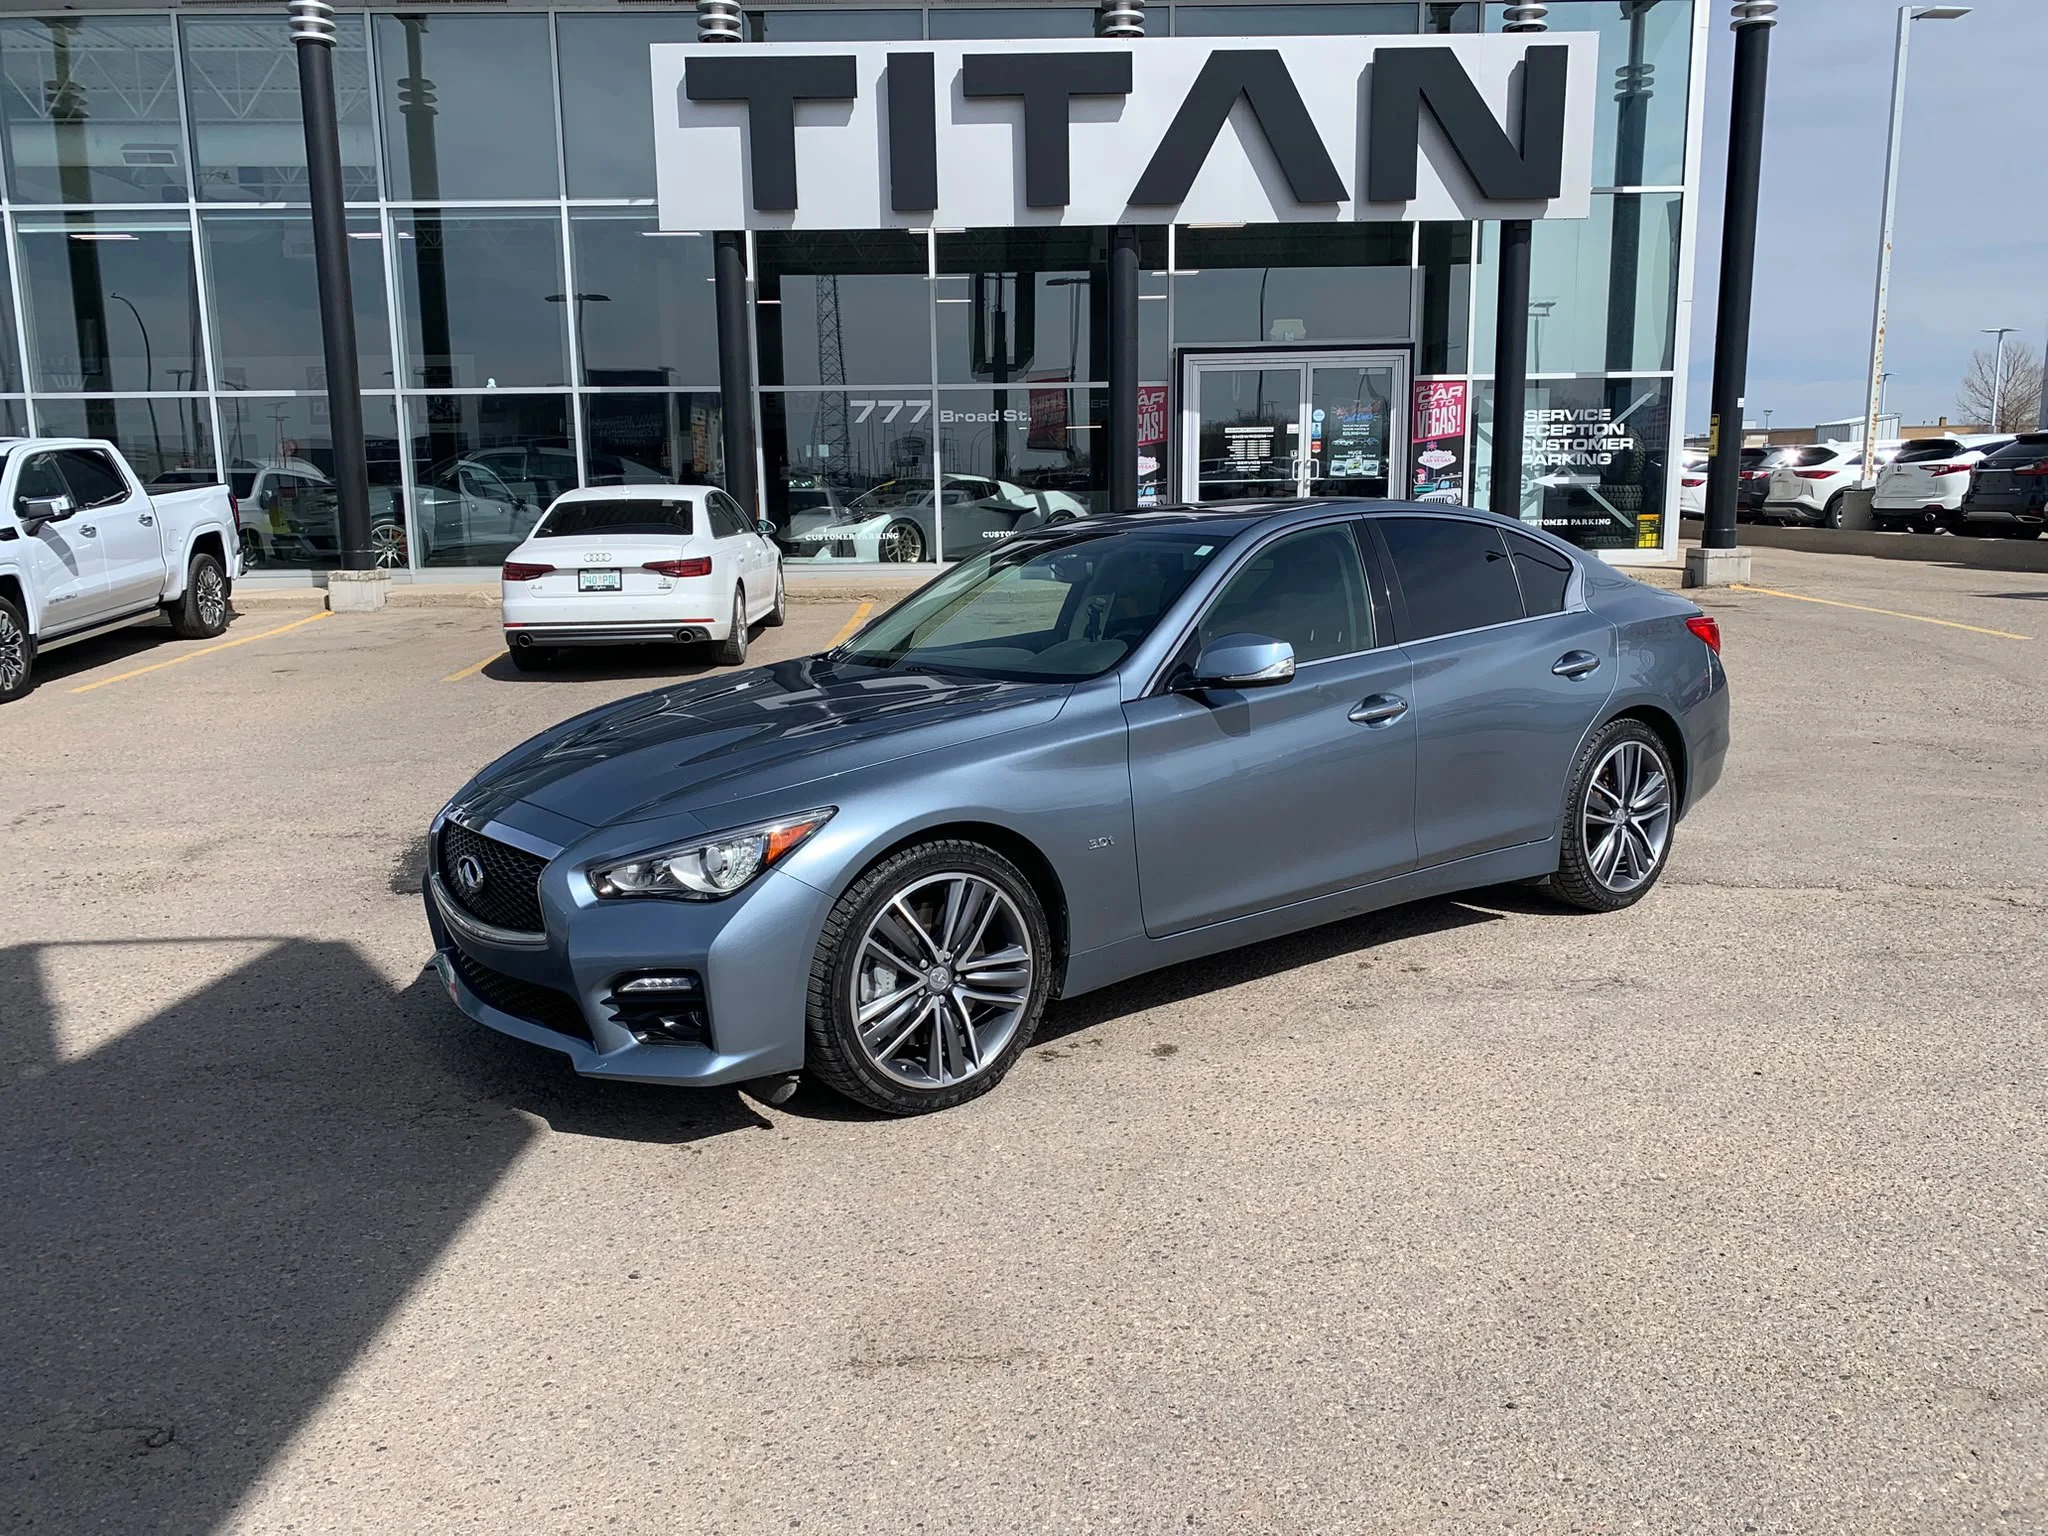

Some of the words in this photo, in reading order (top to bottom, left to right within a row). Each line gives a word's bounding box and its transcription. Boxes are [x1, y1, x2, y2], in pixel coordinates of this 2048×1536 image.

[685, 45, 1568, 211] TITAN
[1416, 384, 1436, 392] BUY
[1138, 392, 1165, 405] AR
[1418, 386, 1463, 403] CAR
[1141, 404, 1157, 413] TO
[1419, 402, 1437, 410] GO
[1439, 399, 1455, 407] TO
[850, 400, 931, 423] 777
[940, 410, 999, 422] Broad
[1003, 409, 1032, 422] St.
[1524, 409, 1611, 421] SERVICE
[1138, 410, 1164, 442] GAS!
[1417, 405, 1462, 438] VEGAS!
[1523, 424, 1625, 436] ECEPTION
[1523, 438, 1634, 450] CUSTOMER
[1521, 453, 1612, 466] PARKING
[805, 533, 854, 541] CUSTOMER
[582, 576, 597, 584] 740
